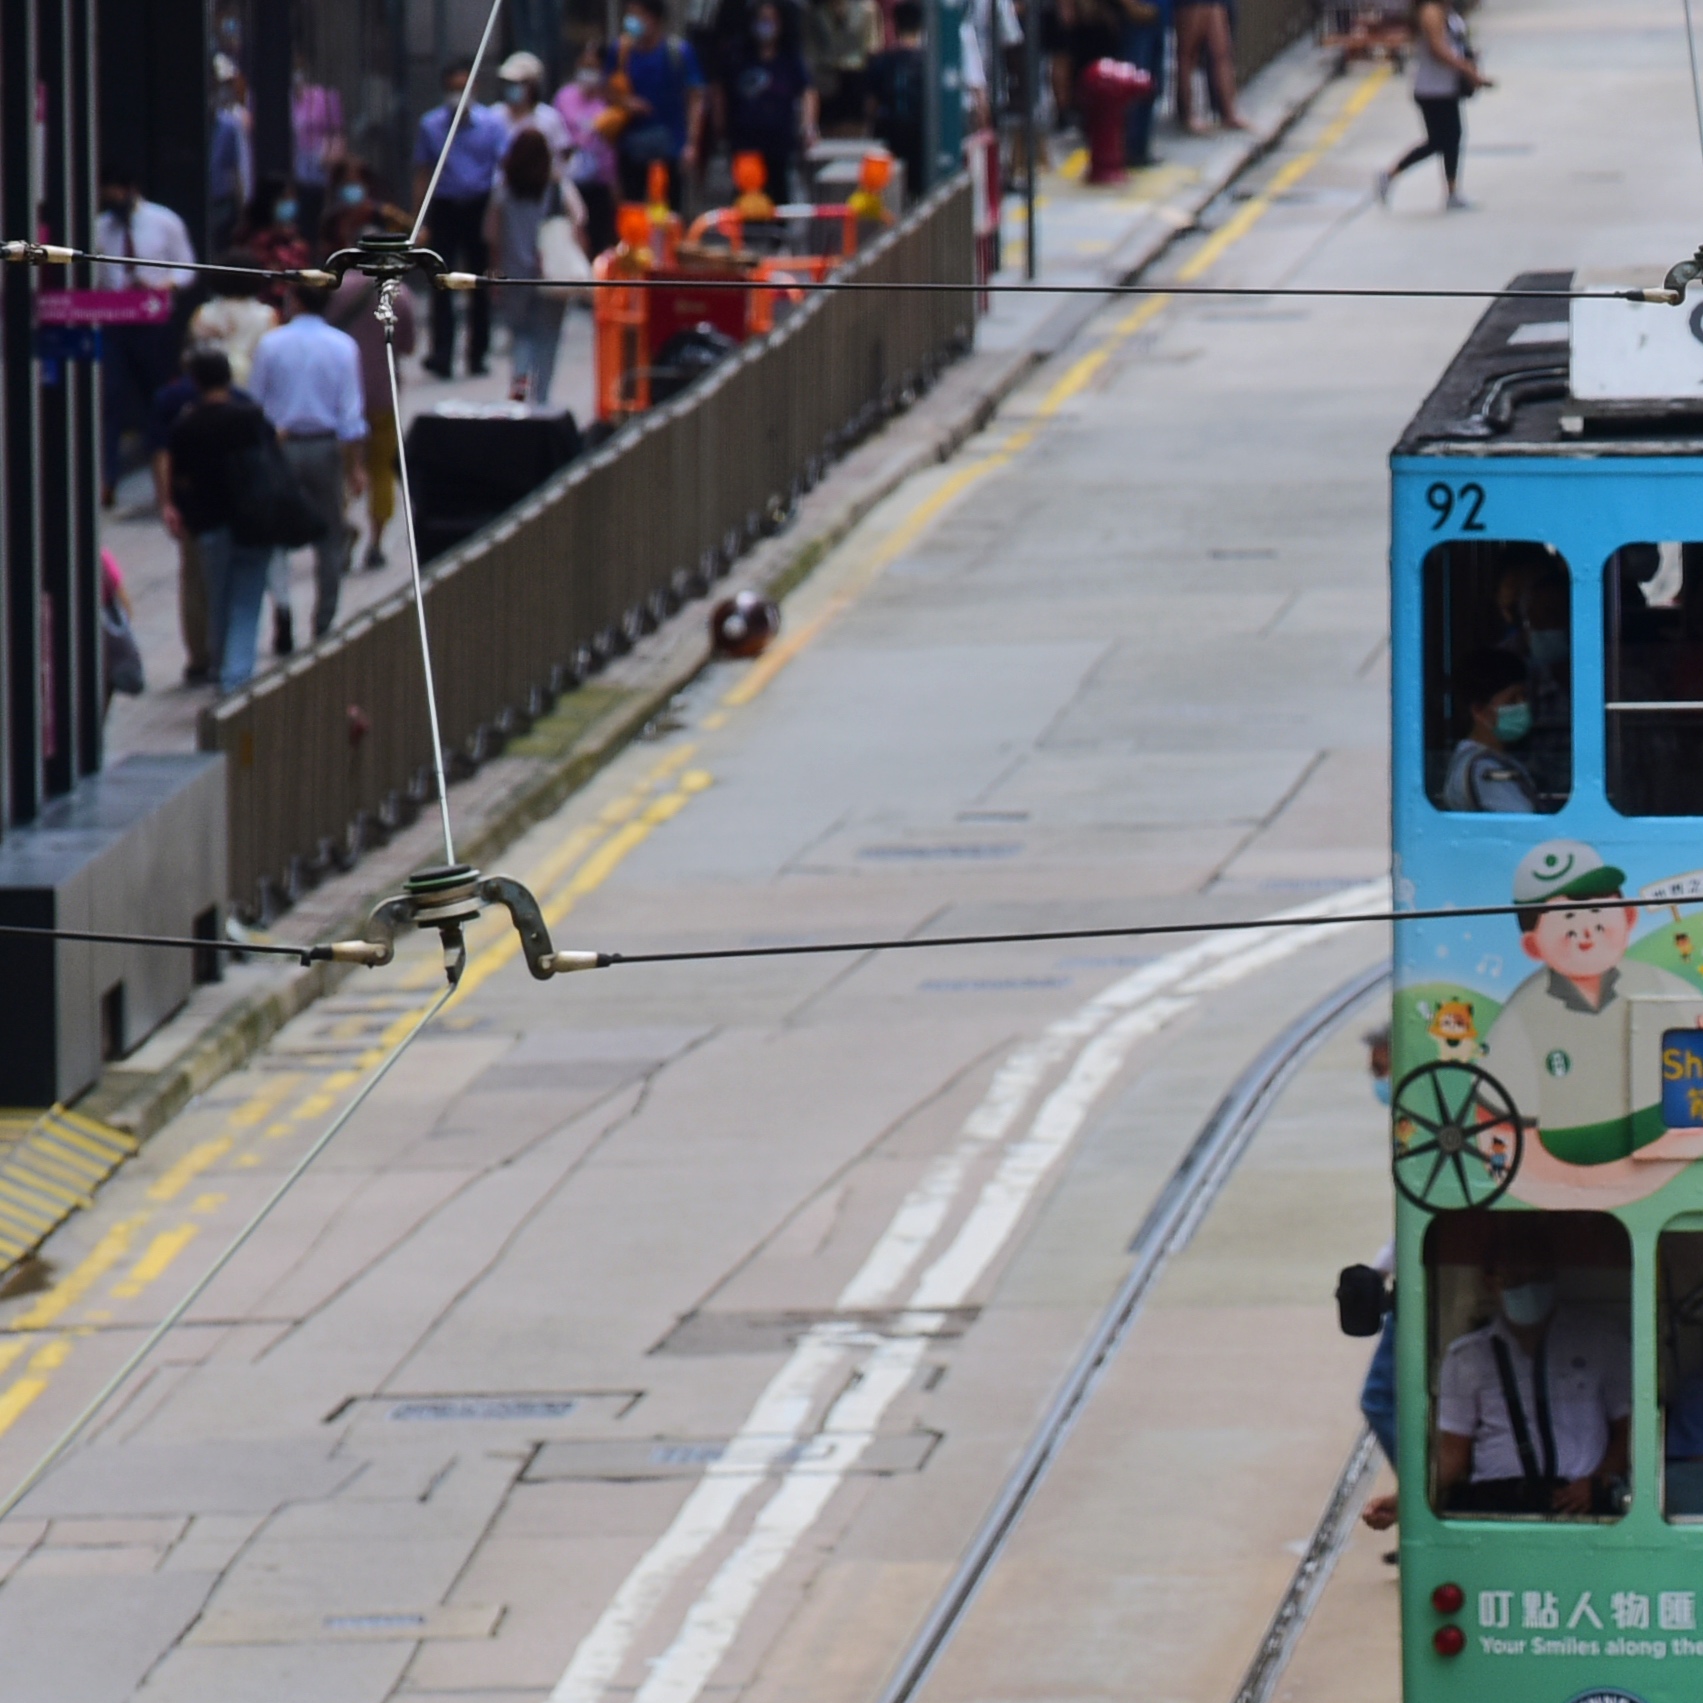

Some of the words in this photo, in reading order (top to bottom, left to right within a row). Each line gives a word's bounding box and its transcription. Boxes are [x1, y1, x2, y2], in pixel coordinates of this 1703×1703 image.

[1427, 483, 1486, 530] 92
[1480, 1637, 1526, 1654] Your
[1530, 1636, 1600, 1655] Smiles
[1604, 1638, 1667, 1659] along
